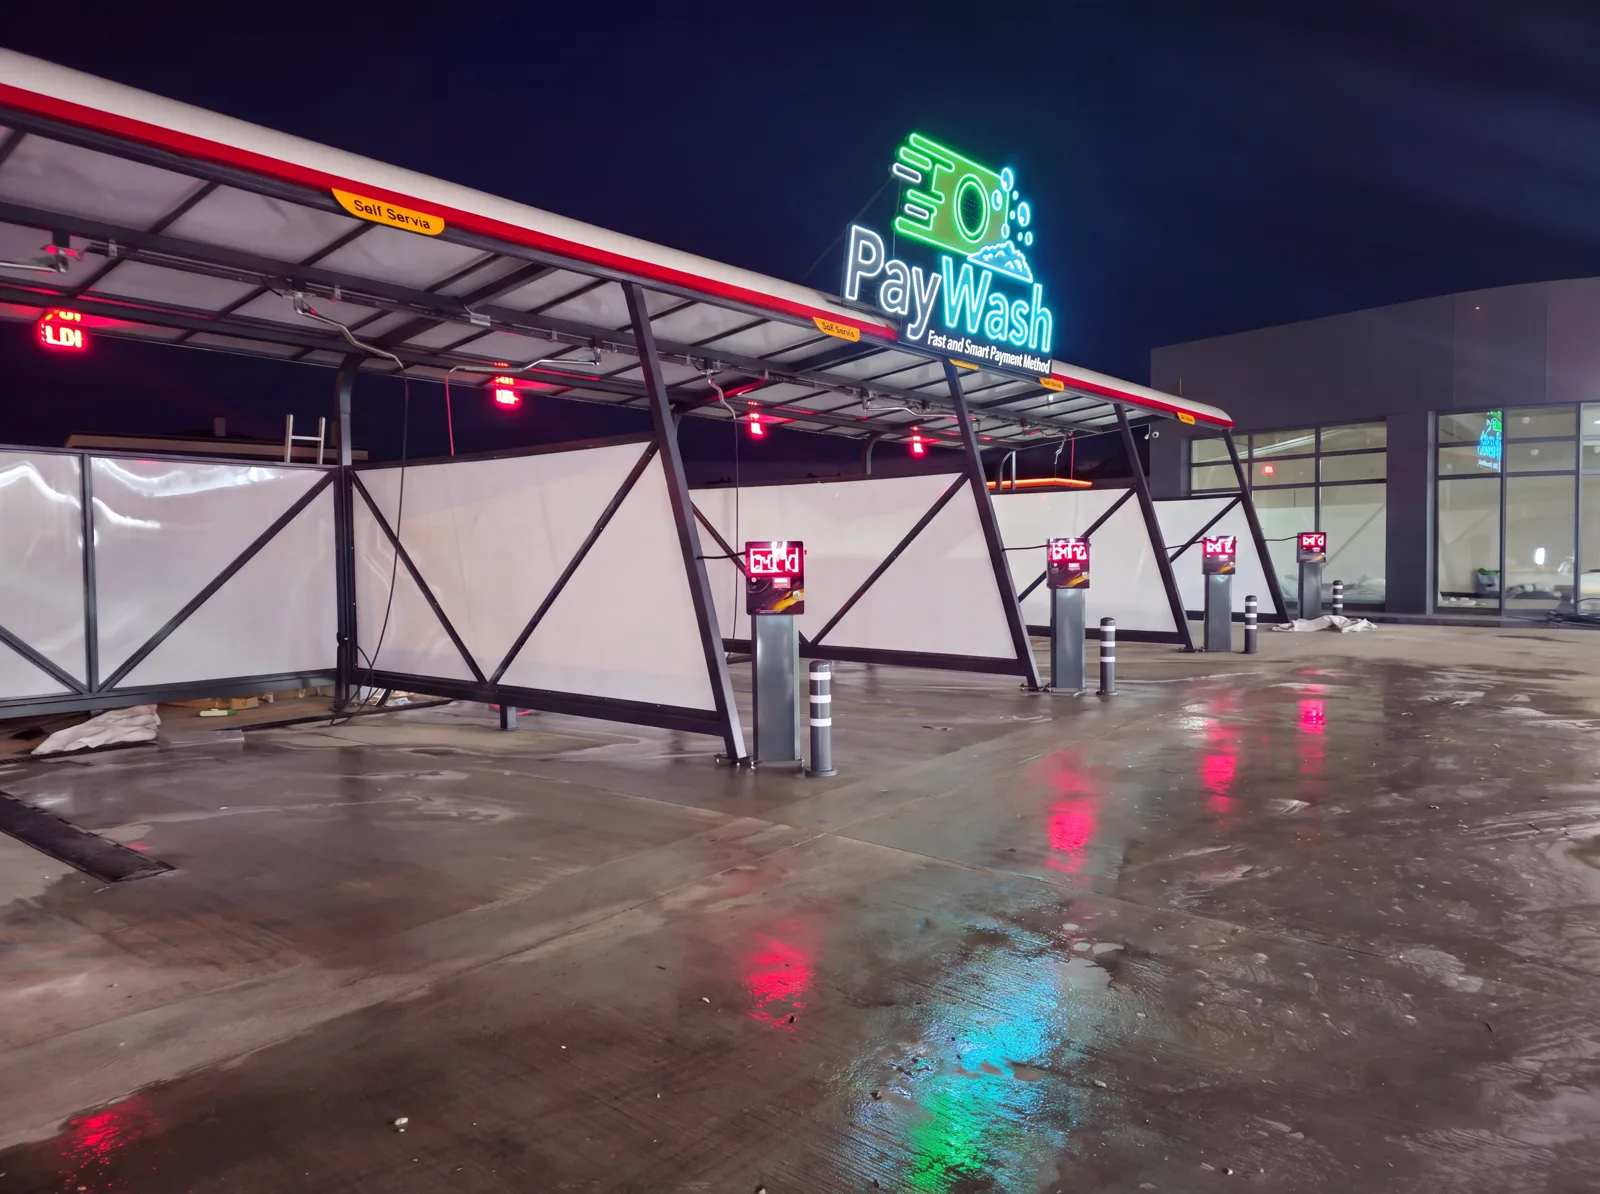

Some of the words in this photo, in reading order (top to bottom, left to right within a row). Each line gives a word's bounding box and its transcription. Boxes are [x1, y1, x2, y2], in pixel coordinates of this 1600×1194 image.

[354, 199, 382, 217] Self
[845, 224, 1052, 353] PayWash
[927, 329, 947, 349] Fast
[947, 337, 965, 353] and
[964, 339, 990, 359] Smart
[990, 345, 1022, 366] Payment
[1022, 353, 1051, 374] Method
